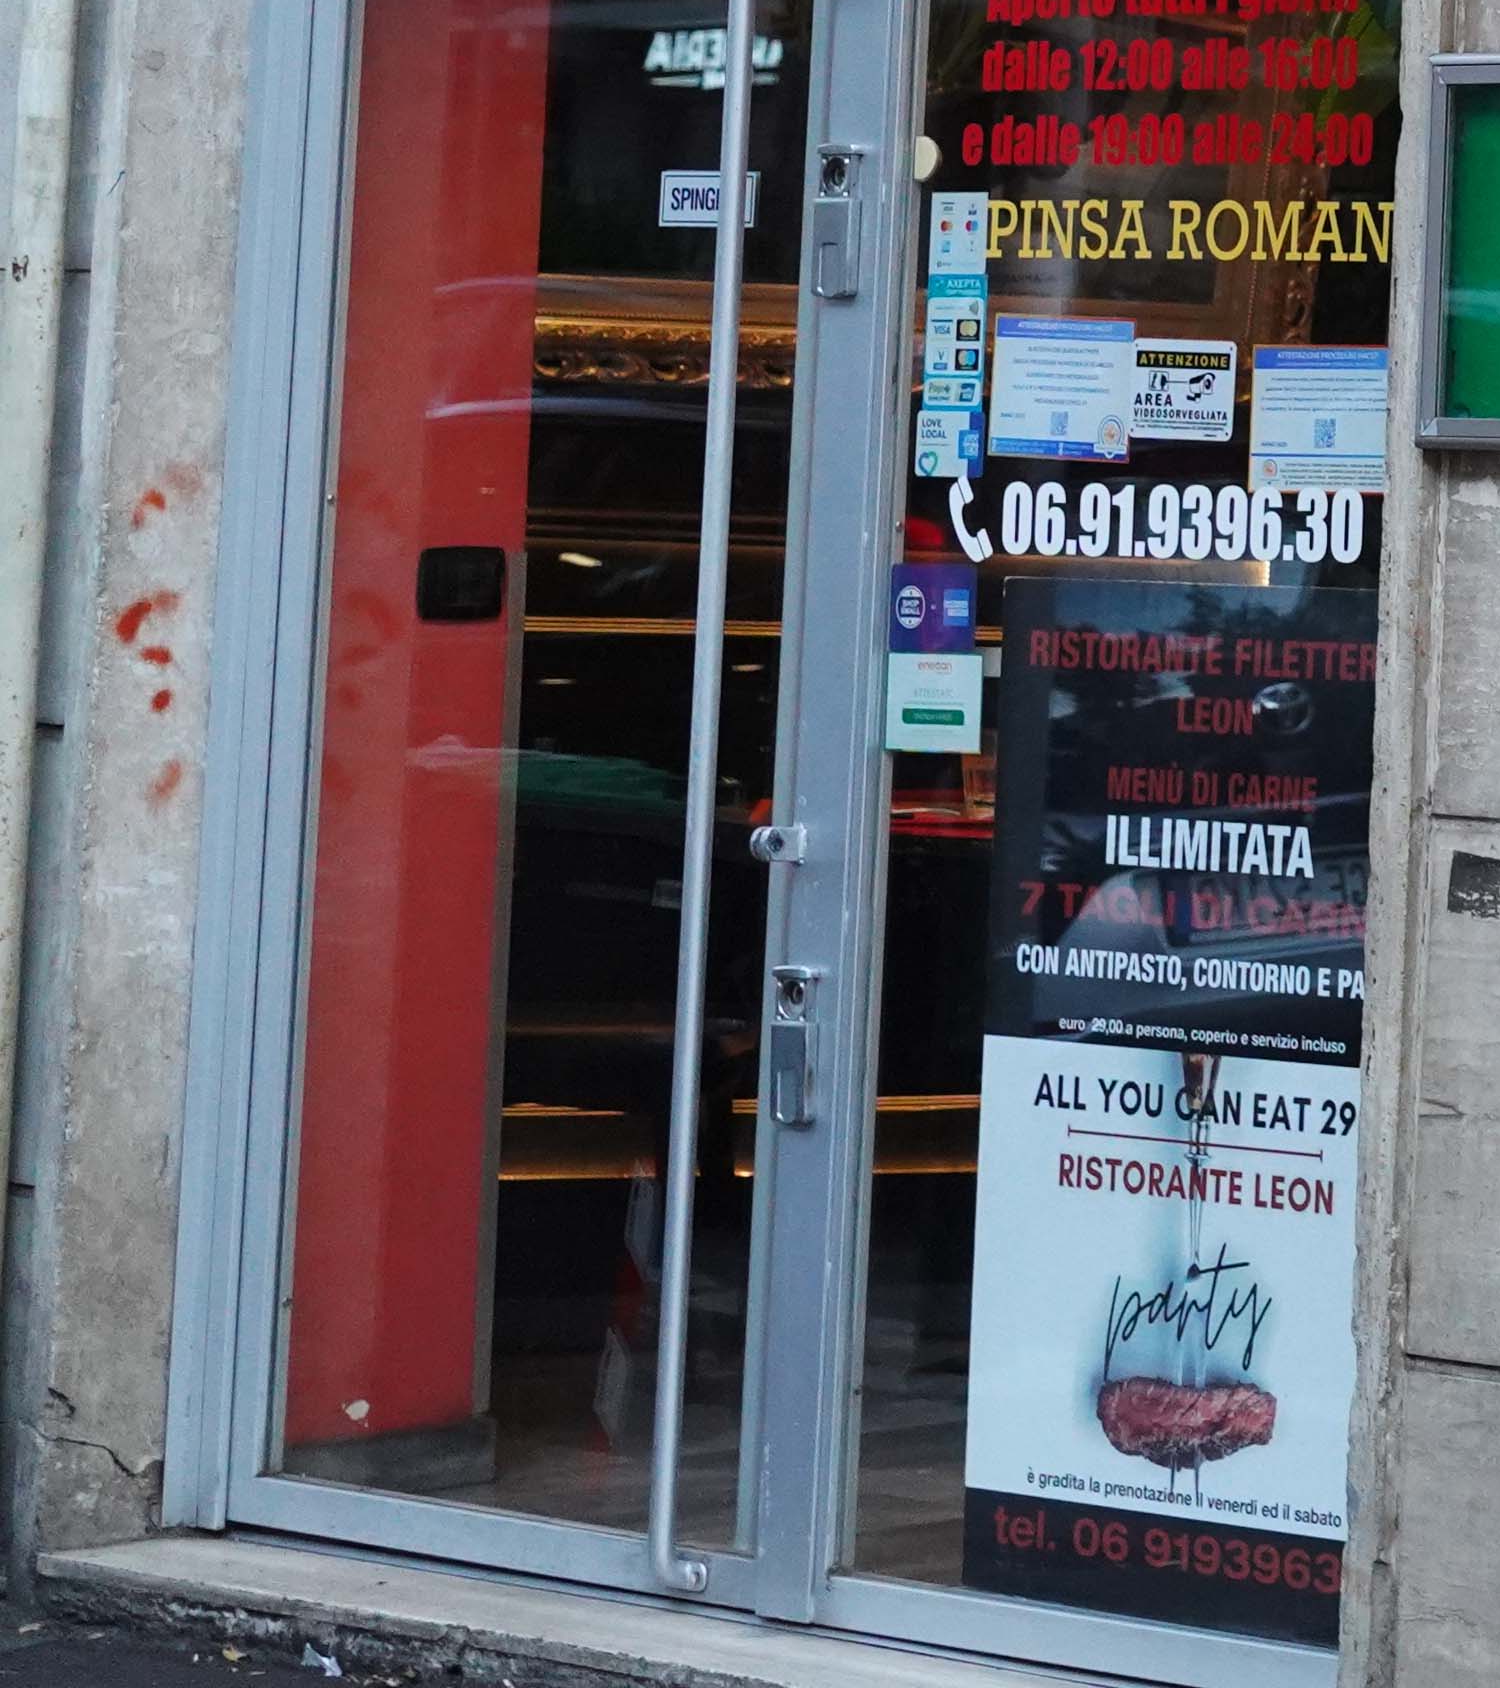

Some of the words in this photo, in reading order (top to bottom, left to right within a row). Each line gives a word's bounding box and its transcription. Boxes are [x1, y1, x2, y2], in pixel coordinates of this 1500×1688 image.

[982, 41, 1071, 92] dalle
[1080, 39, 1174, 92] 12:00
[1181, 38, 1249, 91] alle
[1257, 37, 1359, 91] 16:00
[962, 121, 985, 167] e
[991, 115, 1081, 167] dalle
[1088, 114, 1184, 166] 19:00
[1193, 114, 1265, 166] alle
[1272, 114, 1374, 167] 24:00
[671, 187, 720, 211] SPING
[985, 199, 1152, 260] PINSA
[1139, 352, 1229, 368] ATTENZIONE
[921, 418, 942, 429] LOVE
[1133, 407, 1228, 421] VIDEOSORVEGLIATA
[1134, 393, 1173, 407] AREA
[921, 429, 947, 439] LOCAL
[1001, 480, 1365, 564] 06.91.9396.30
[1030, 628, 1224, 677] RISTORANTE
[1176, 695, 1256, 736] LEON
[1107, 761, 1185, 805] MENÙ
[1192, 770, 1220, 808] DI
[1228, 775, 1318, 813] CARNE
[1104, 813, 1316, 879] ILLIMITATA
[1017, 880, 1046, 916] 7
[1058, 882, 1176, 927] TAGLI
[1191, 892, 1233, 931] DI
[1016, 943, 1060, 977] CON
[1066, 947, 1188, 992] ANTIPASTO,
[1193, 955, 1312, 997] CONTORNO
[1317, 967, 1332, 999] E
[1058, 1017, 1086, 1032] euro
[1090, 1017, 1124, 1036] 29,00
[1125, 1024, 1134, 1036] a
[1136, 1024, 1188, 1043] persona,
[1190, 1028, 1238, 1045] coperto
[1240, 1033, 1249, 1045] e
[1251, 1033, 1299, 1051] servizio
[1301, 1036, 1346, 1055] incluso
[1034, 1073, 1087, 1112] ALL
[1097, 1078, 1164, 1118] YOU
[1174, 1084, 1241, 1127] CAN
[1253, 1093, 1311, 1134] EAT
[1320, 1099, 1357, 1138] 29
[1058, 1153, 1243, 1208] RISTORANTE
[1253, 1175, 1335, 1216] LEON
[1104, 1243, 1272, 1380] party
[1027, 1466, 1035, 1484] è
[1038, 1473, 1085, 1490] gradita
[1089, 1476, 1100, 1493] la
[1104, 1481, 1192, 1507] prenotazione
[1261, 1503, 1279, 1519] ed
[1282, 1504, 1290, 1521] il
[1294, 1508, 1342, 1528] sabato
[994, 1505, 1057, 1551] tel.
[1072, 1517, 1129, 1562] 06
[1144, 1527, 1344, 1595] 9193963
